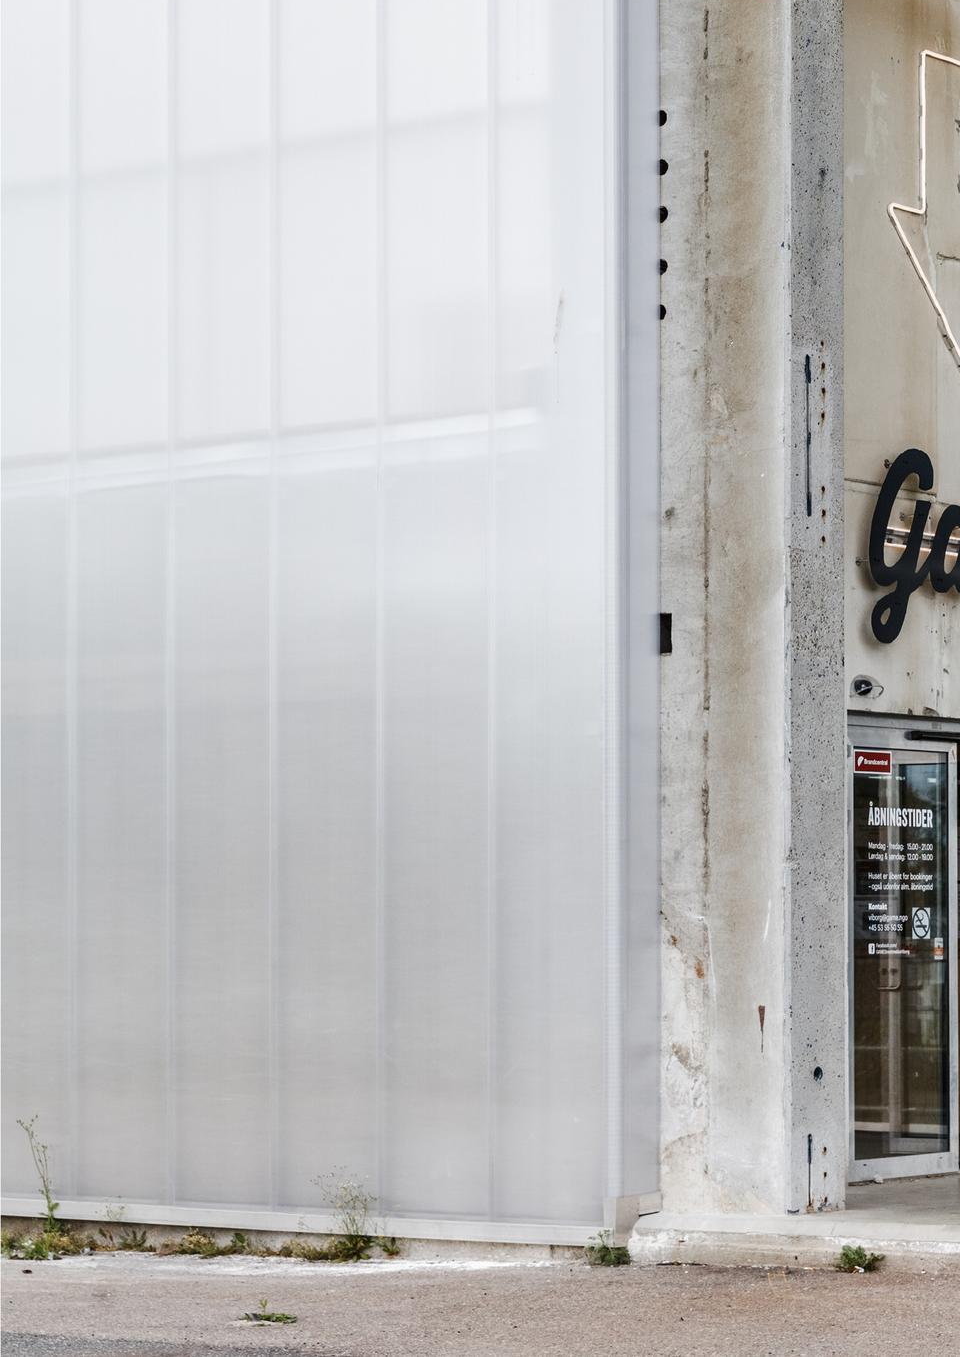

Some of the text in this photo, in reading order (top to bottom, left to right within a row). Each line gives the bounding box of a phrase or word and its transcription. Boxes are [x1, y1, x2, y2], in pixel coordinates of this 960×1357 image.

[867, 800, 934, 829] ÅBNINGSTIDER
[868, 841, 887, 851] Mandag
[868, 872, 882, 880] Huset
[868, 902, 888, 911] Kontakt
